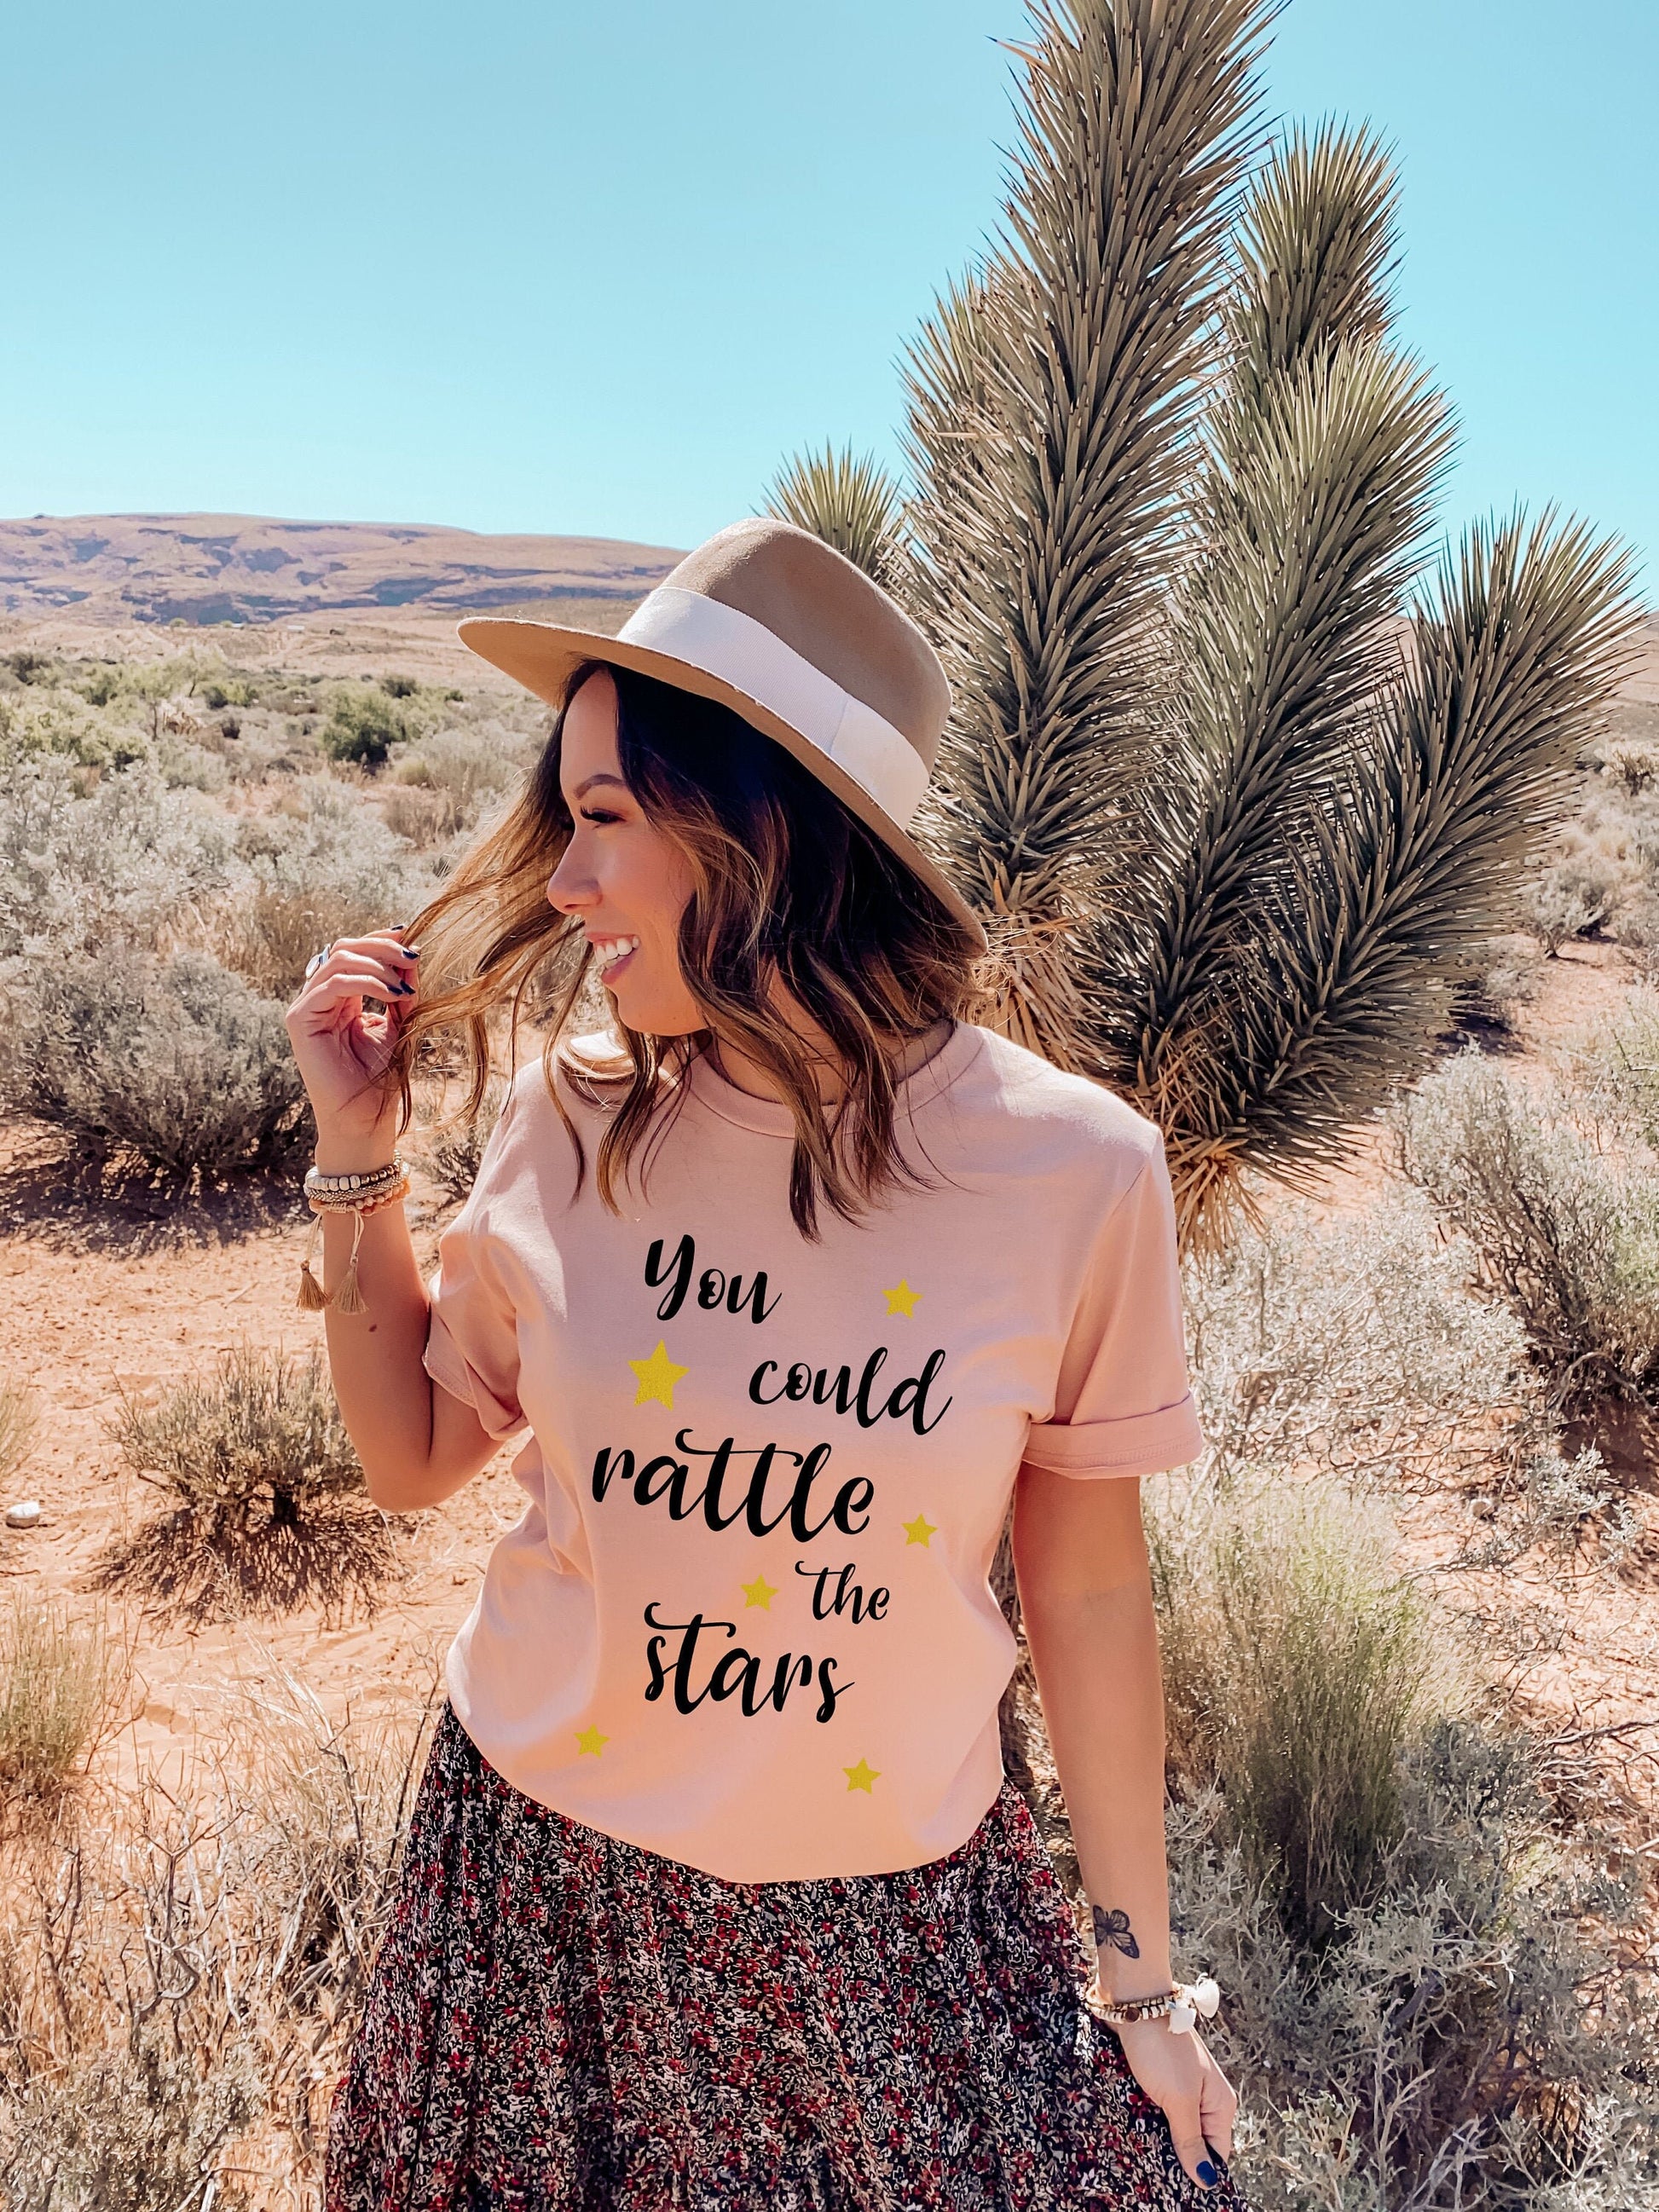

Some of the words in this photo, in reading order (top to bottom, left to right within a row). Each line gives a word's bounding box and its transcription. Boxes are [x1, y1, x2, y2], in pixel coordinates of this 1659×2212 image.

[645, 1234, 782, 1324] You
[749, 1347, 953, 1435] could
[592, 1429, 875, 1543] rattle
[795, 1560, 890, 1625] the
[645, 1602, 855, 1724] stars
